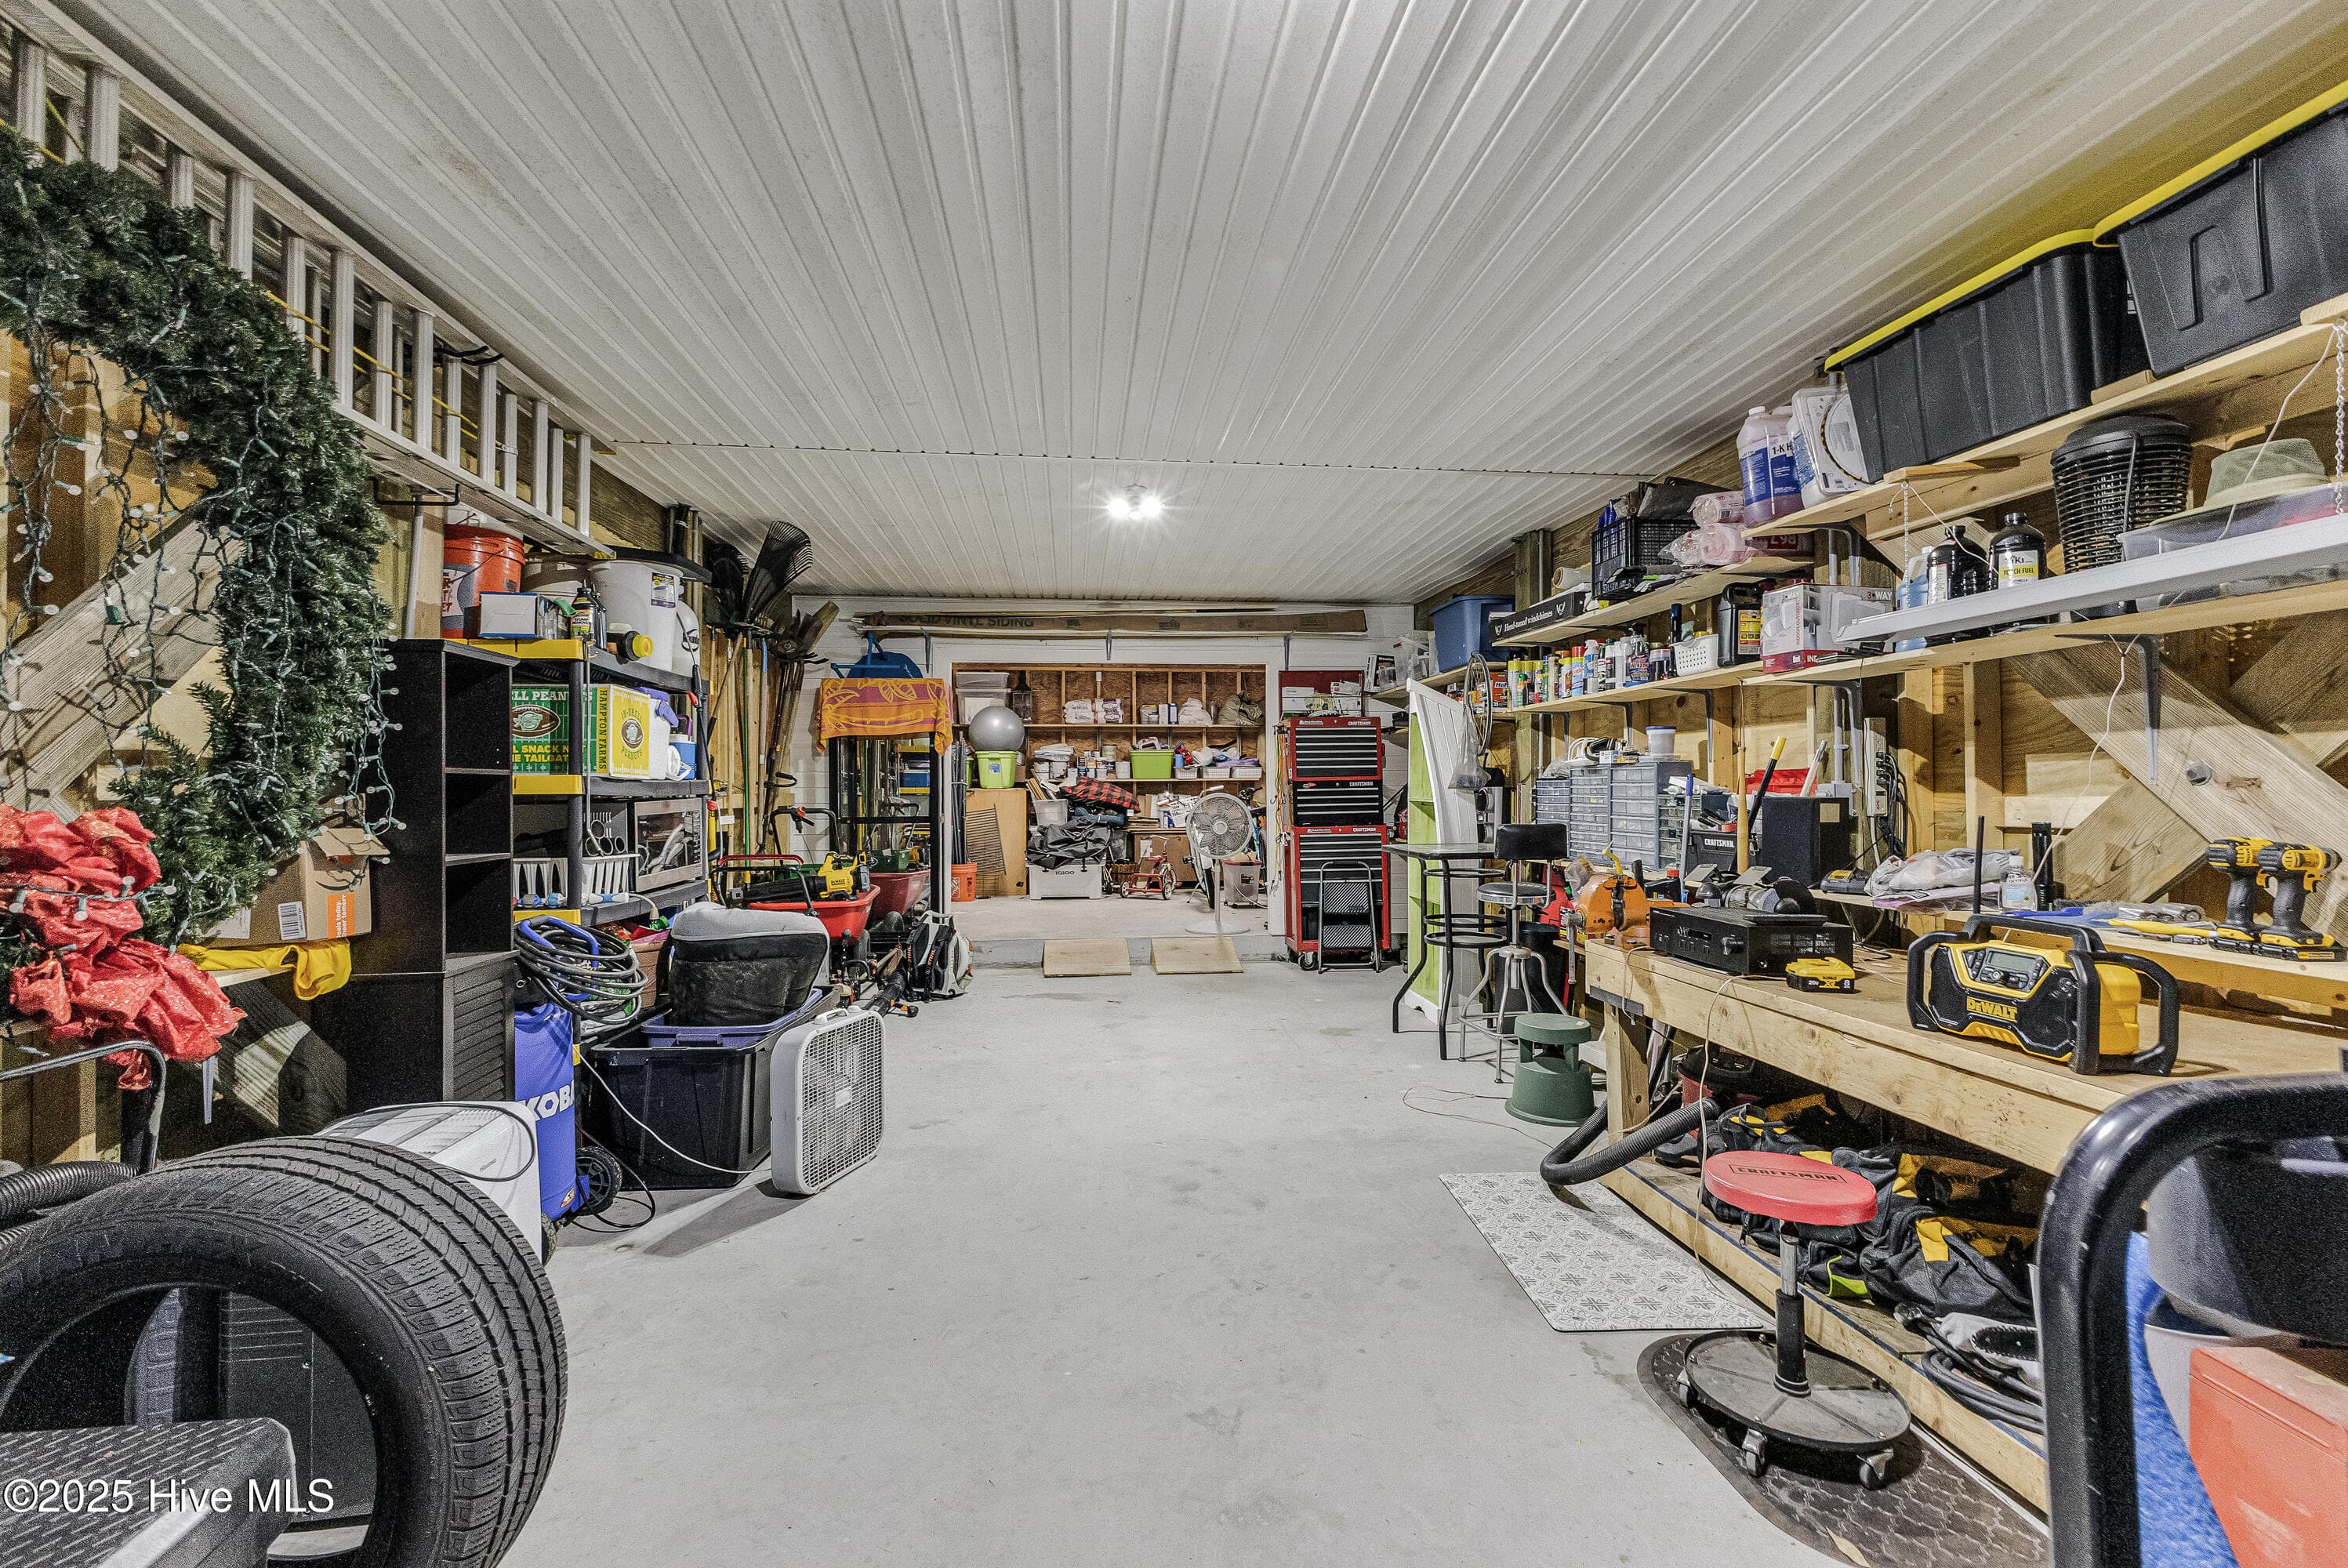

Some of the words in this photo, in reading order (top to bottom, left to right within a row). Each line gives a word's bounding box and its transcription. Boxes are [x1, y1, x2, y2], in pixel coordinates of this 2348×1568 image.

[945, 615, 984, 626] VINYL
[988, 617, 1034, 627] SIDING
[1504, 617, 1527, 632] Hand-tuned
[1528, 611, 1553, 624] windchimes
[1704, 838, 1736, 848] CRAFTSMAN
[927, 948, 936, 966] STIHL
[1967, 997, 2018, 1022] DEWALT
[1737, 1167, 1838, 1181] CRAFTSMAN
